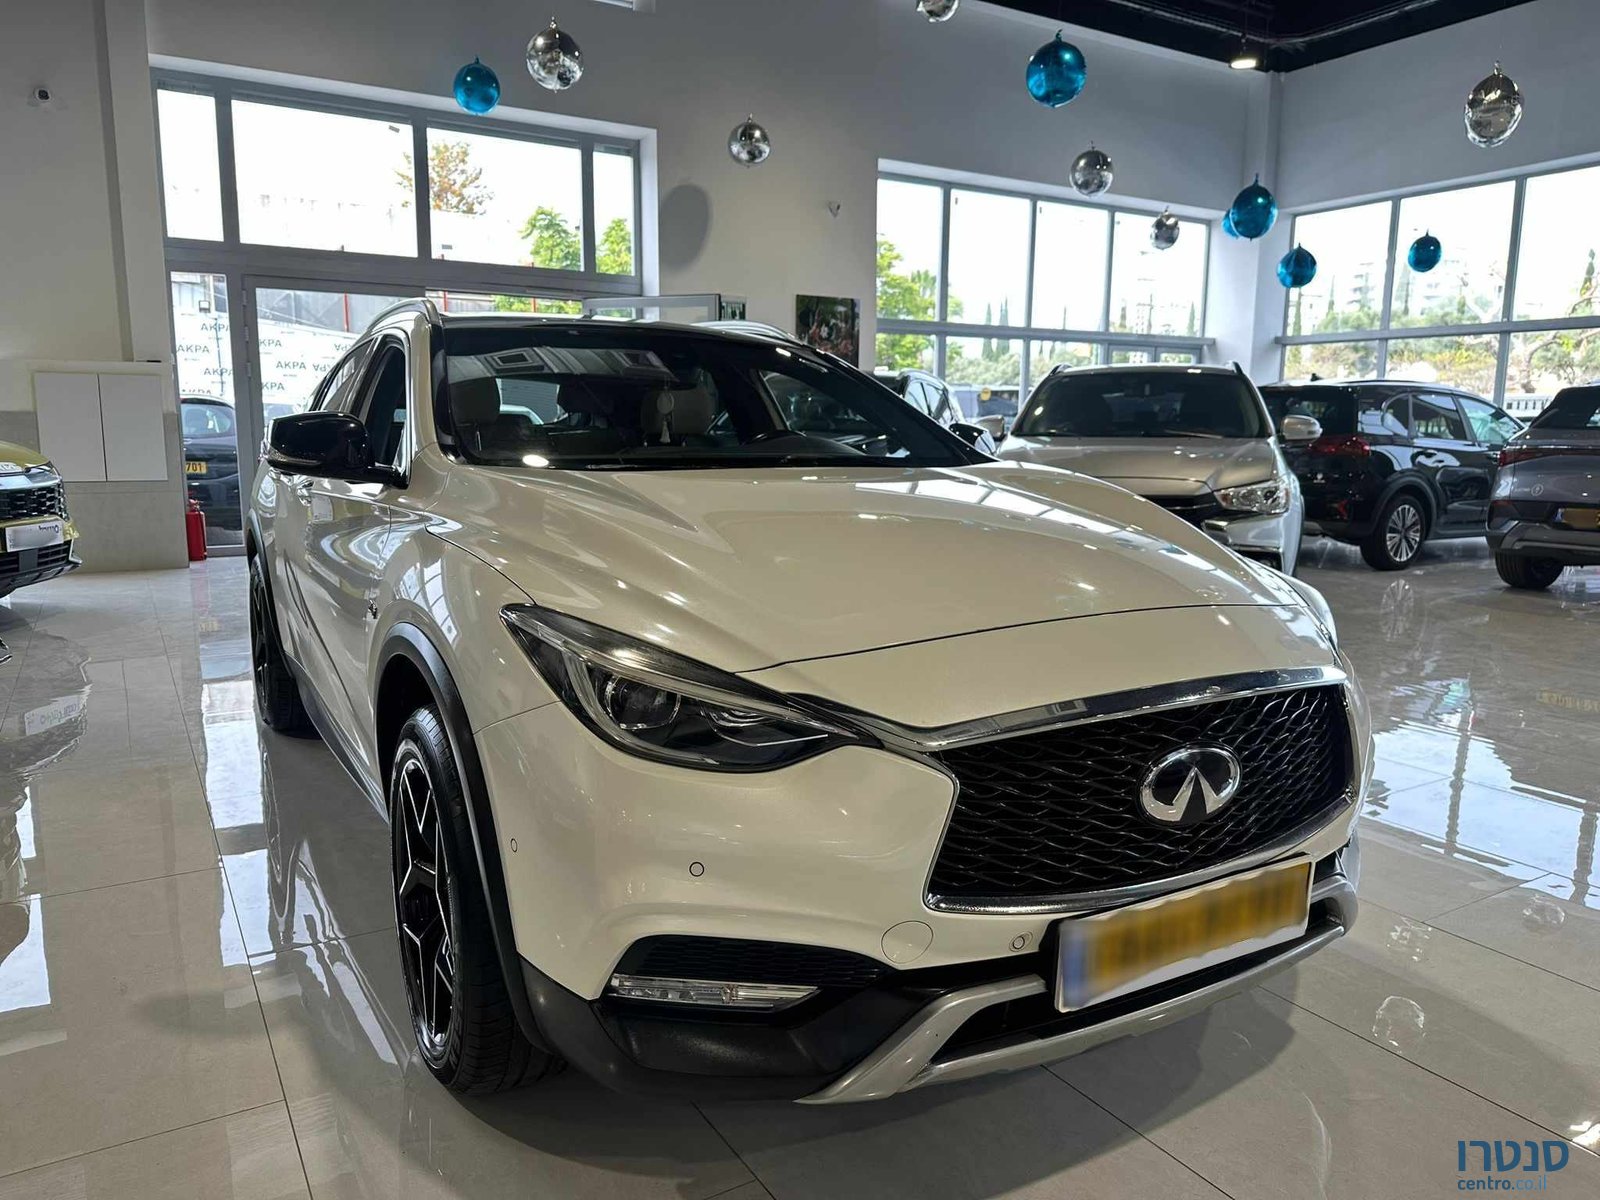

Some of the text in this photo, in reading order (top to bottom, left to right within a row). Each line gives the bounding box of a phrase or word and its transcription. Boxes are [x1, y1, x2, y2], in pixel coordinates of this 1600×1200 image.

[260, 339, 282, 347] KPA
[177, 344, 210, 353] AKPA
[276, 361, 307, 370] AKPA
[262, 382, 285, 390] KPA
